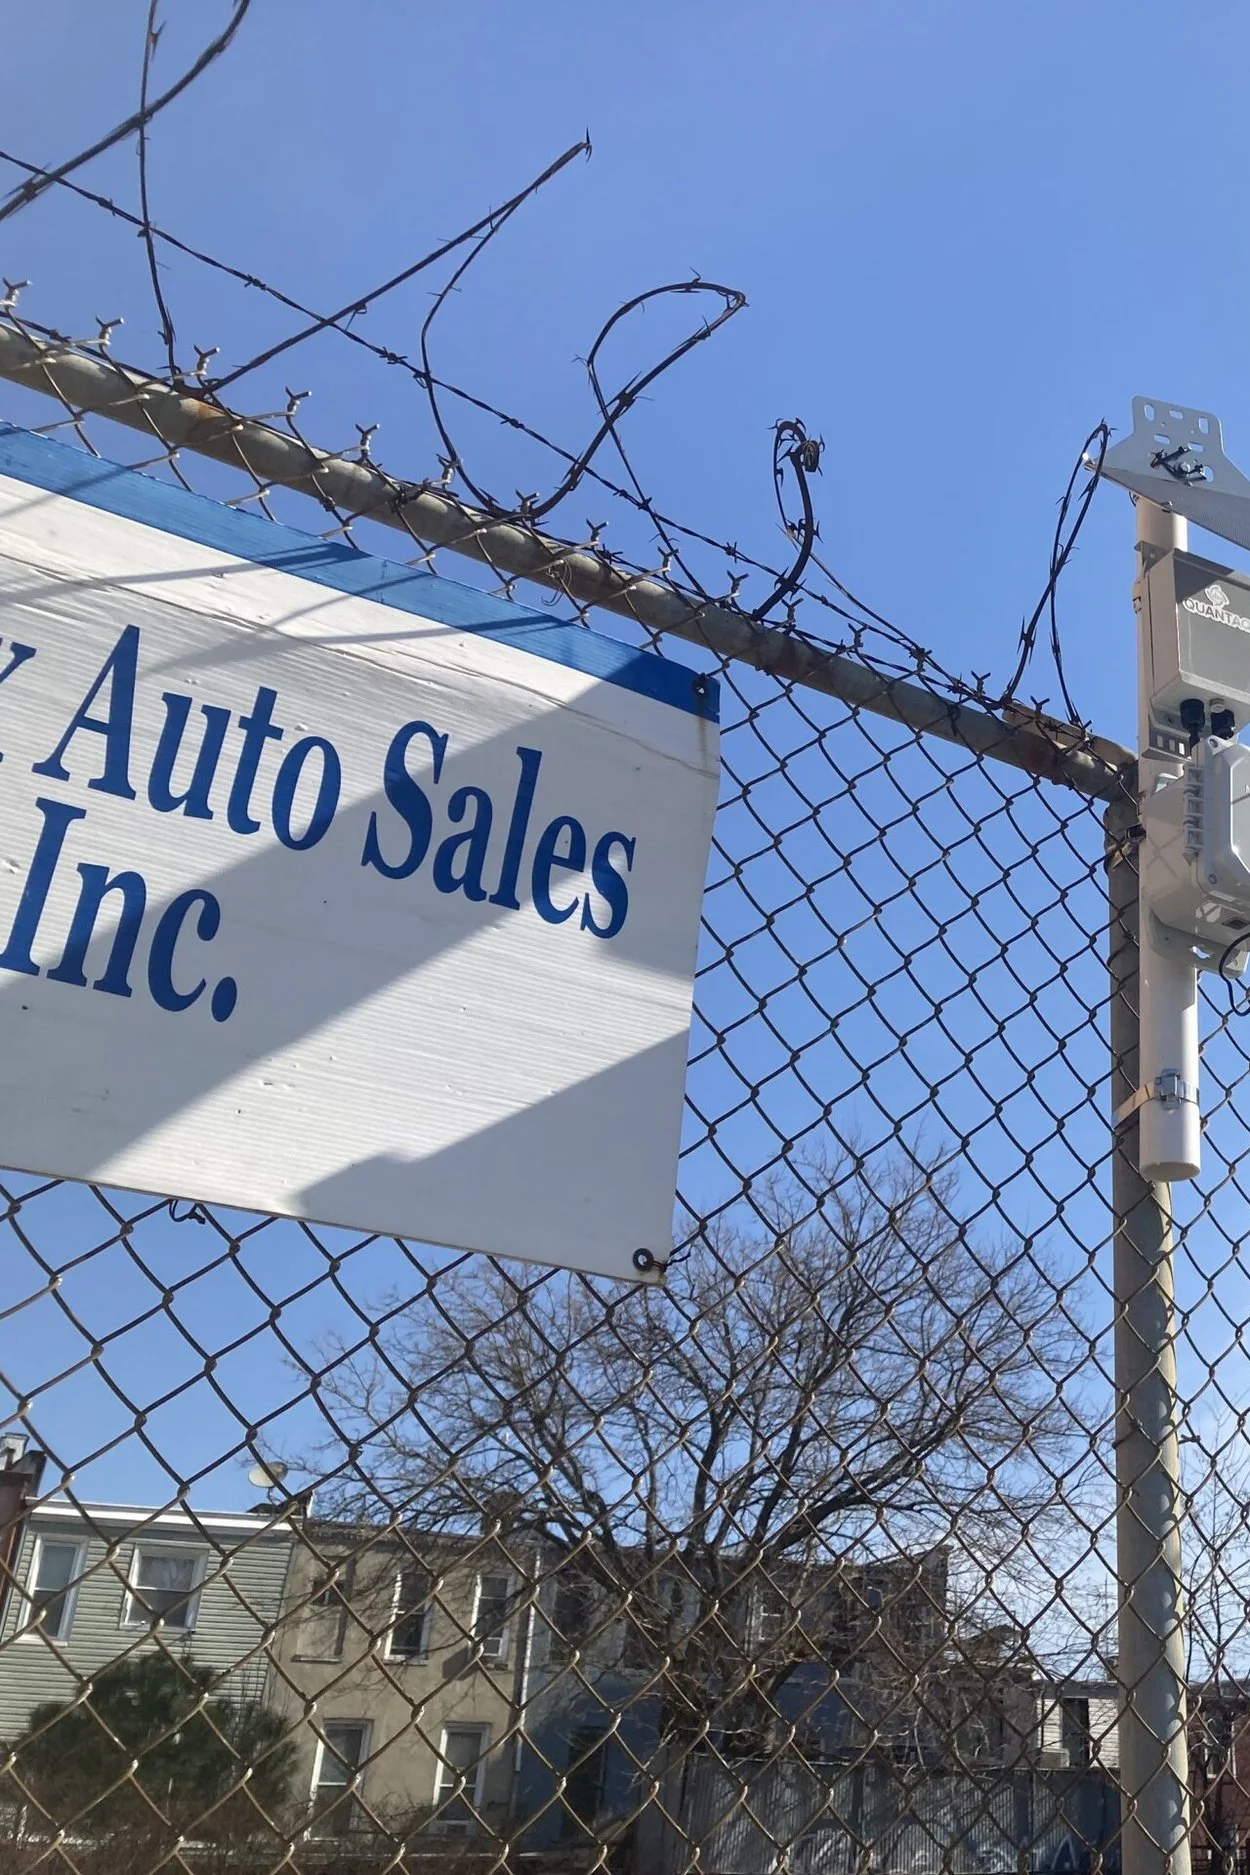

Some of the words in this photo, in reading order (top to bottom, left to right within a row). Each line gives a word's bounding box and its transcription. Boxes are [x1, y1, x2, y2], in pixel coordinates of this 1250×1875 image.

[0, 797, 237, 1022] Inc.
[32, 625, 341, 851] Auto
[361, 720, 637, 939] Sales
